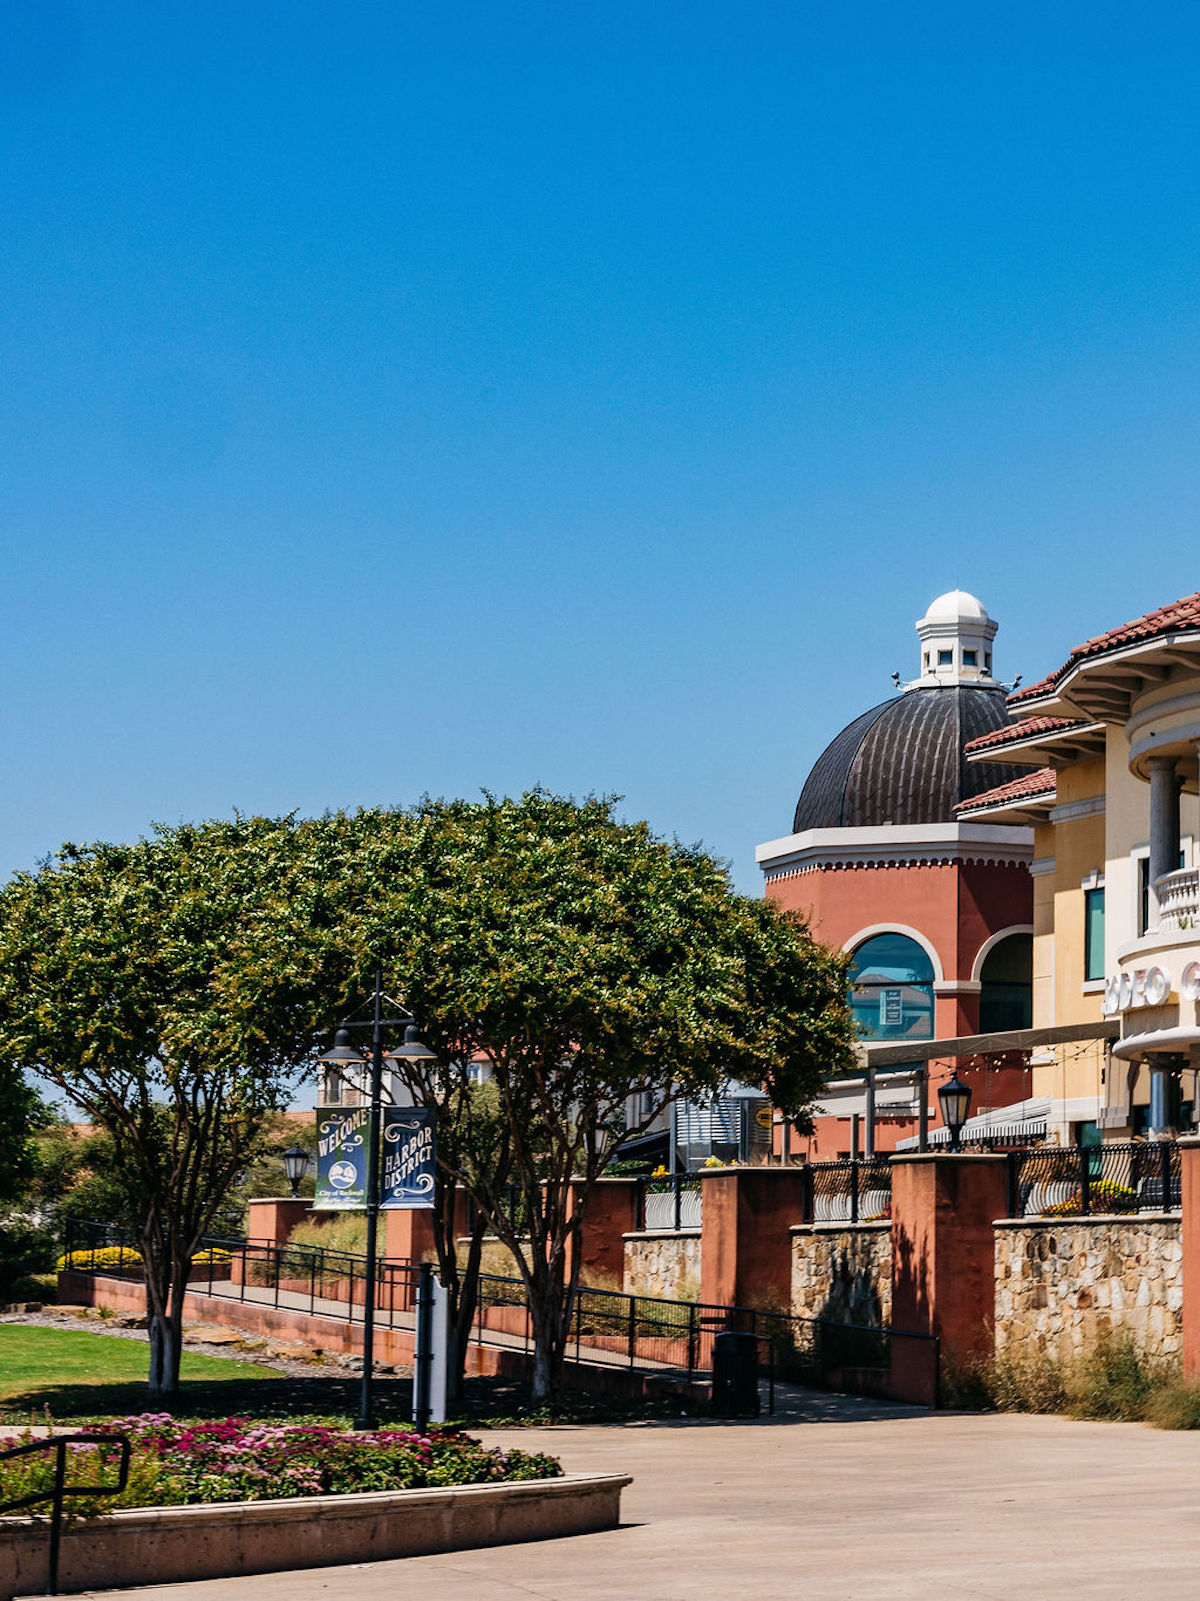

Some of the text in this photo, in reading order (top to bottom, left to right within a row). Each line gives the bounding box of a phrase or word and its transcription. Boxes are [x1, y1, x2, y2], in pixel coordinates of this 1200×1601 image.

[317, 1108, 368, 1157] WELCOME
[385, 1126, 432, 1173] HARBOR
[384, 1145, 433, 1190] DISTRICT
